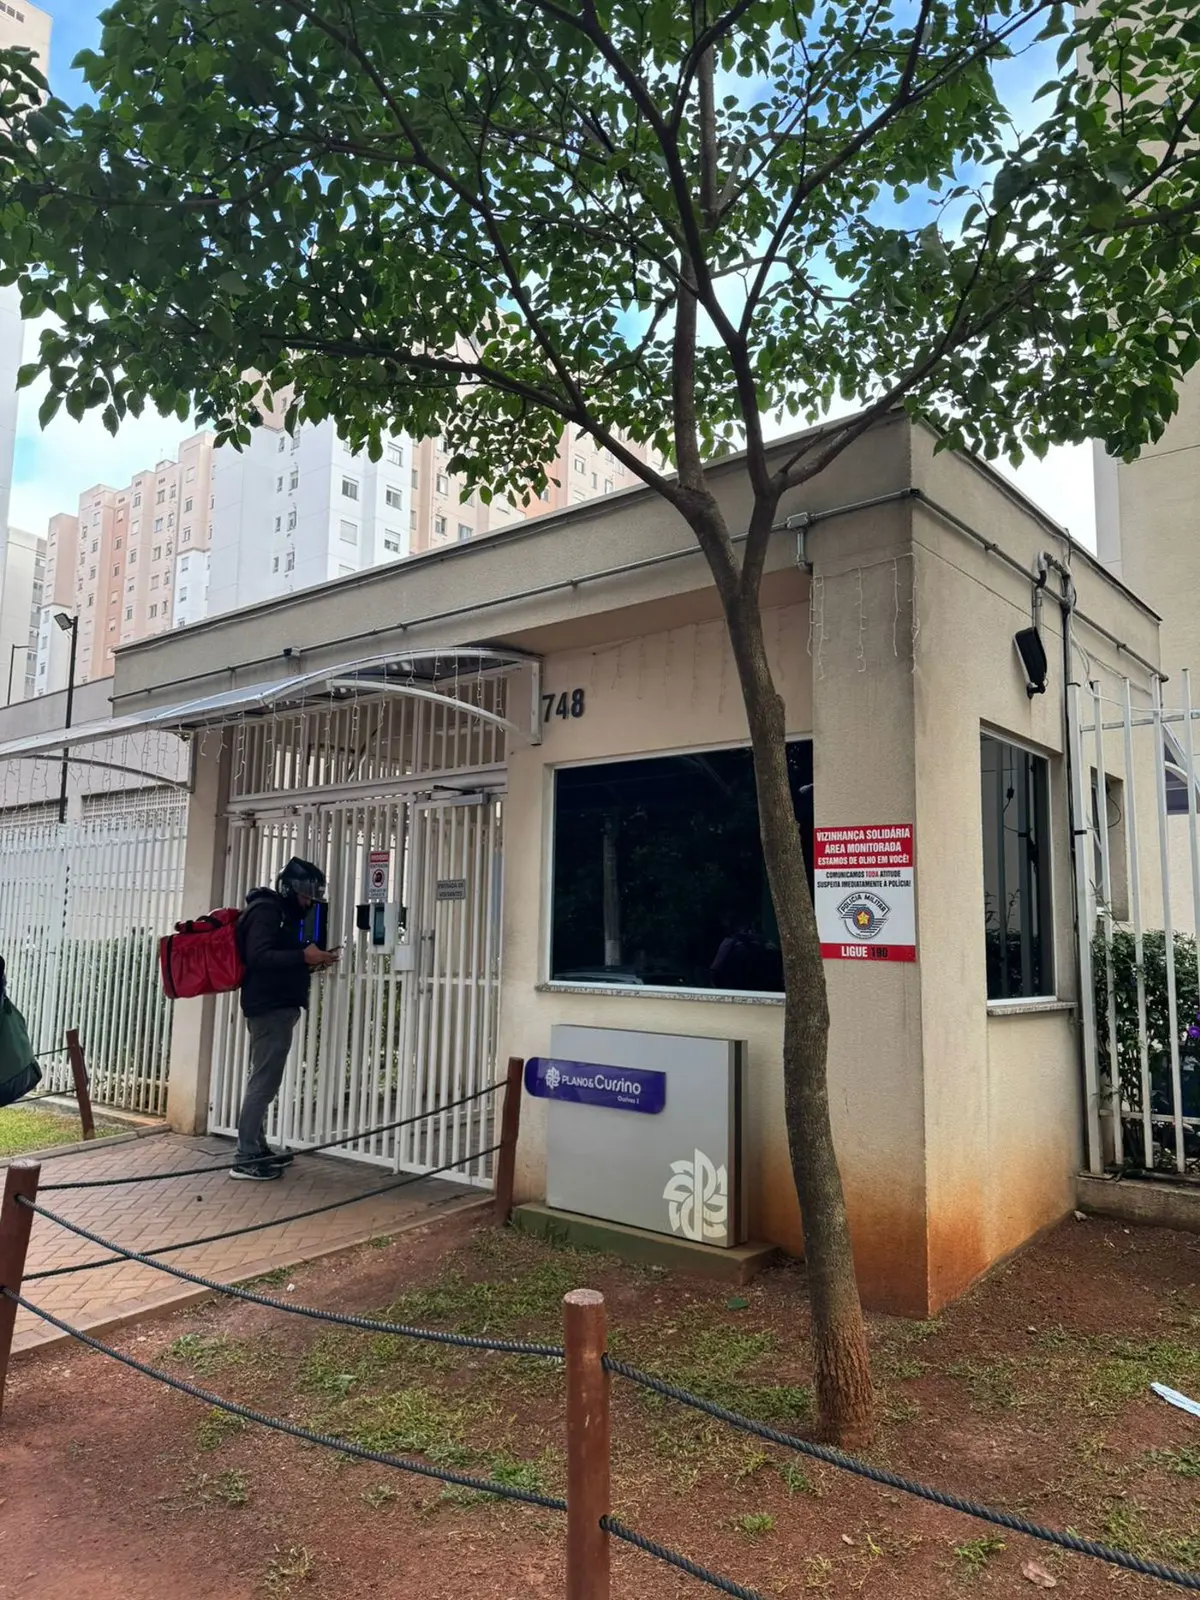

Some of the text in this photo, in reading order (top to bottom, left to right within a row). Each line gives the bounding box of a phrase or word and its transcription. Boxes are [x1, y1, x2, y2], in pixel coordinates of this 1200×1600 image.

[542, 688, 585, 723] 748
[816, 826, 910, 842] VIZINHANÇA SOLIDÁRIA
[824, 842, 902, 854] ÁREA MONITORADA
[818, 853, 909, 865] ESTAMOS DE OLHO EM VOCÊ!
[825, 871, 864, 879] COMUNICAMOS
[865, 870, 880, 878] TODA
[841, 880, 883, 888] IMEDIATAMENTE
[864, 894, 887, 912] MILITAR
[841, 945, 888, 958] LIGUE 190
